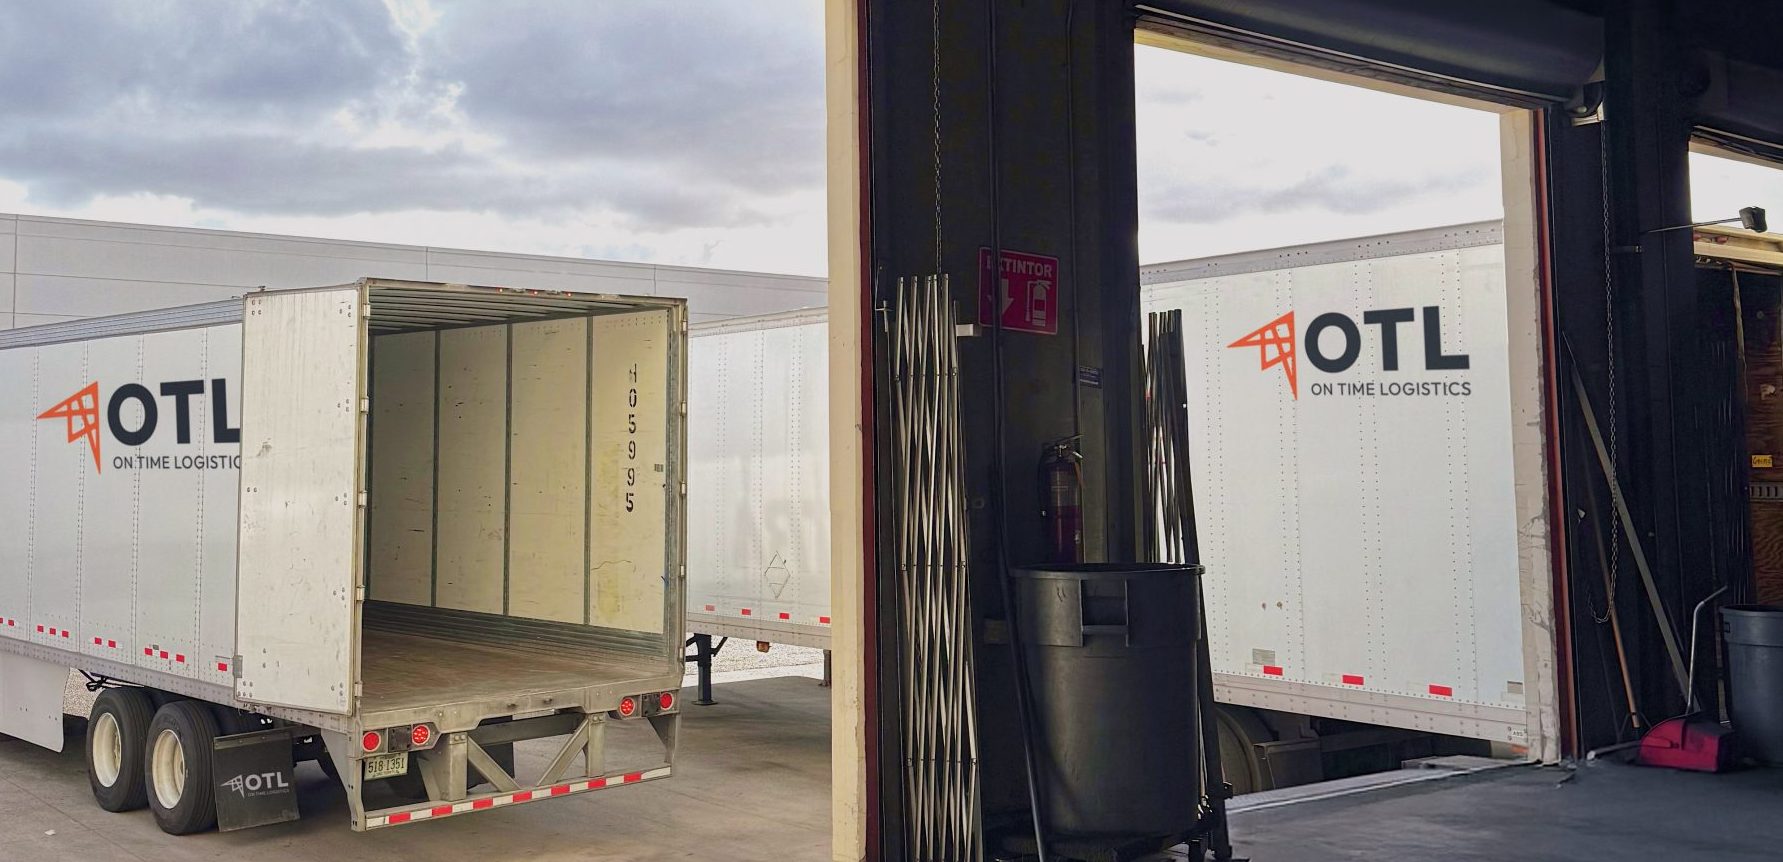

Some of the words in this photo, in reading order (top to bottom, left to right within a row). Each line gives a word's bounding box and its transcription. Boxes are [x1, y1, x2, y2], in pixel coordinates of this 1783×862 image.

[1304, 305, 1470, 374] OTL
[1311, 383, 1333, 396] ON
[1337, 382, 1375, 396] TIME
[1380, 381, 1472, 396] LOGISTICS
[107, 378, 241, 446] OTL
[113, 456, 133, 470] ON
[137, 456, 170, 470] TIME
[245, 772, 288, 790] OTL
